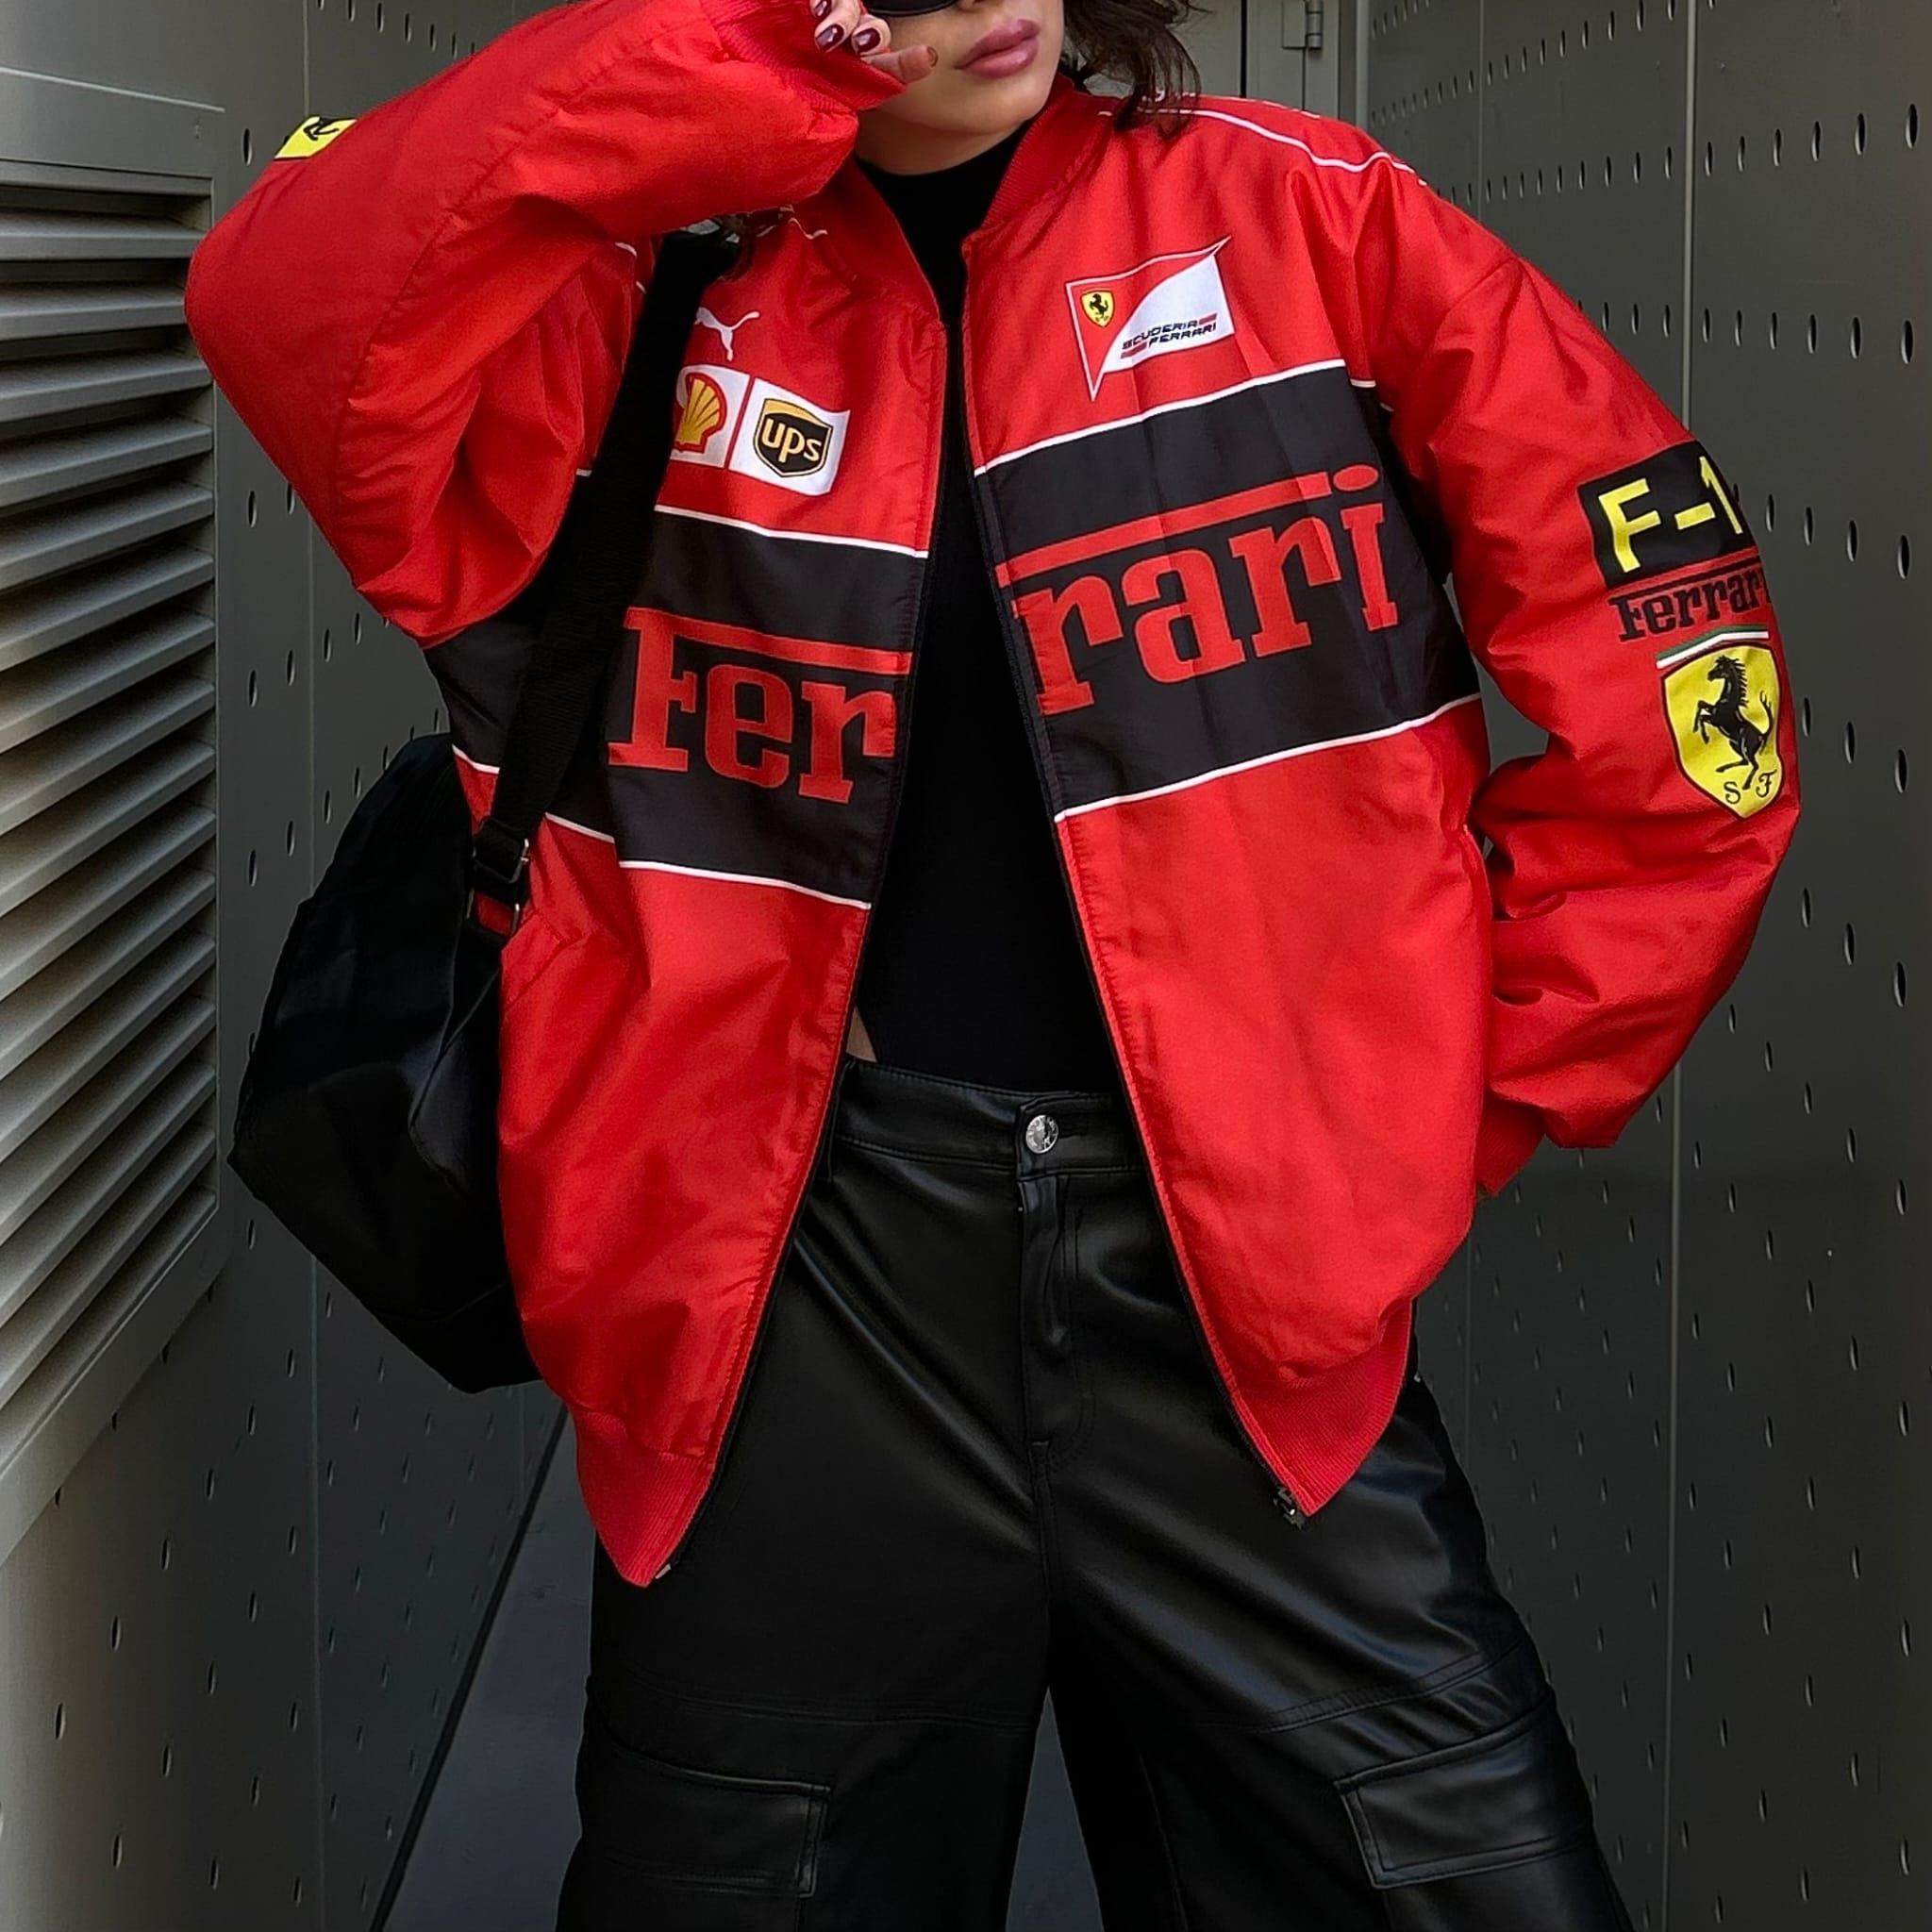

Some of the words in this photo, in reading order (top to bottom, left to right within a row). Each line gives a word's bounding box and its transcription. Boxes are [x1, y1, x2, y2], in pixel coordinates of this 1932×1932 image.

[1122, 319, 1199, 350] SCUDERIA
[1148, 323, 1216, 348] FERRARI
[761, 418, 823, 463] ups
[1598, 456, 1743, 573] F-1
